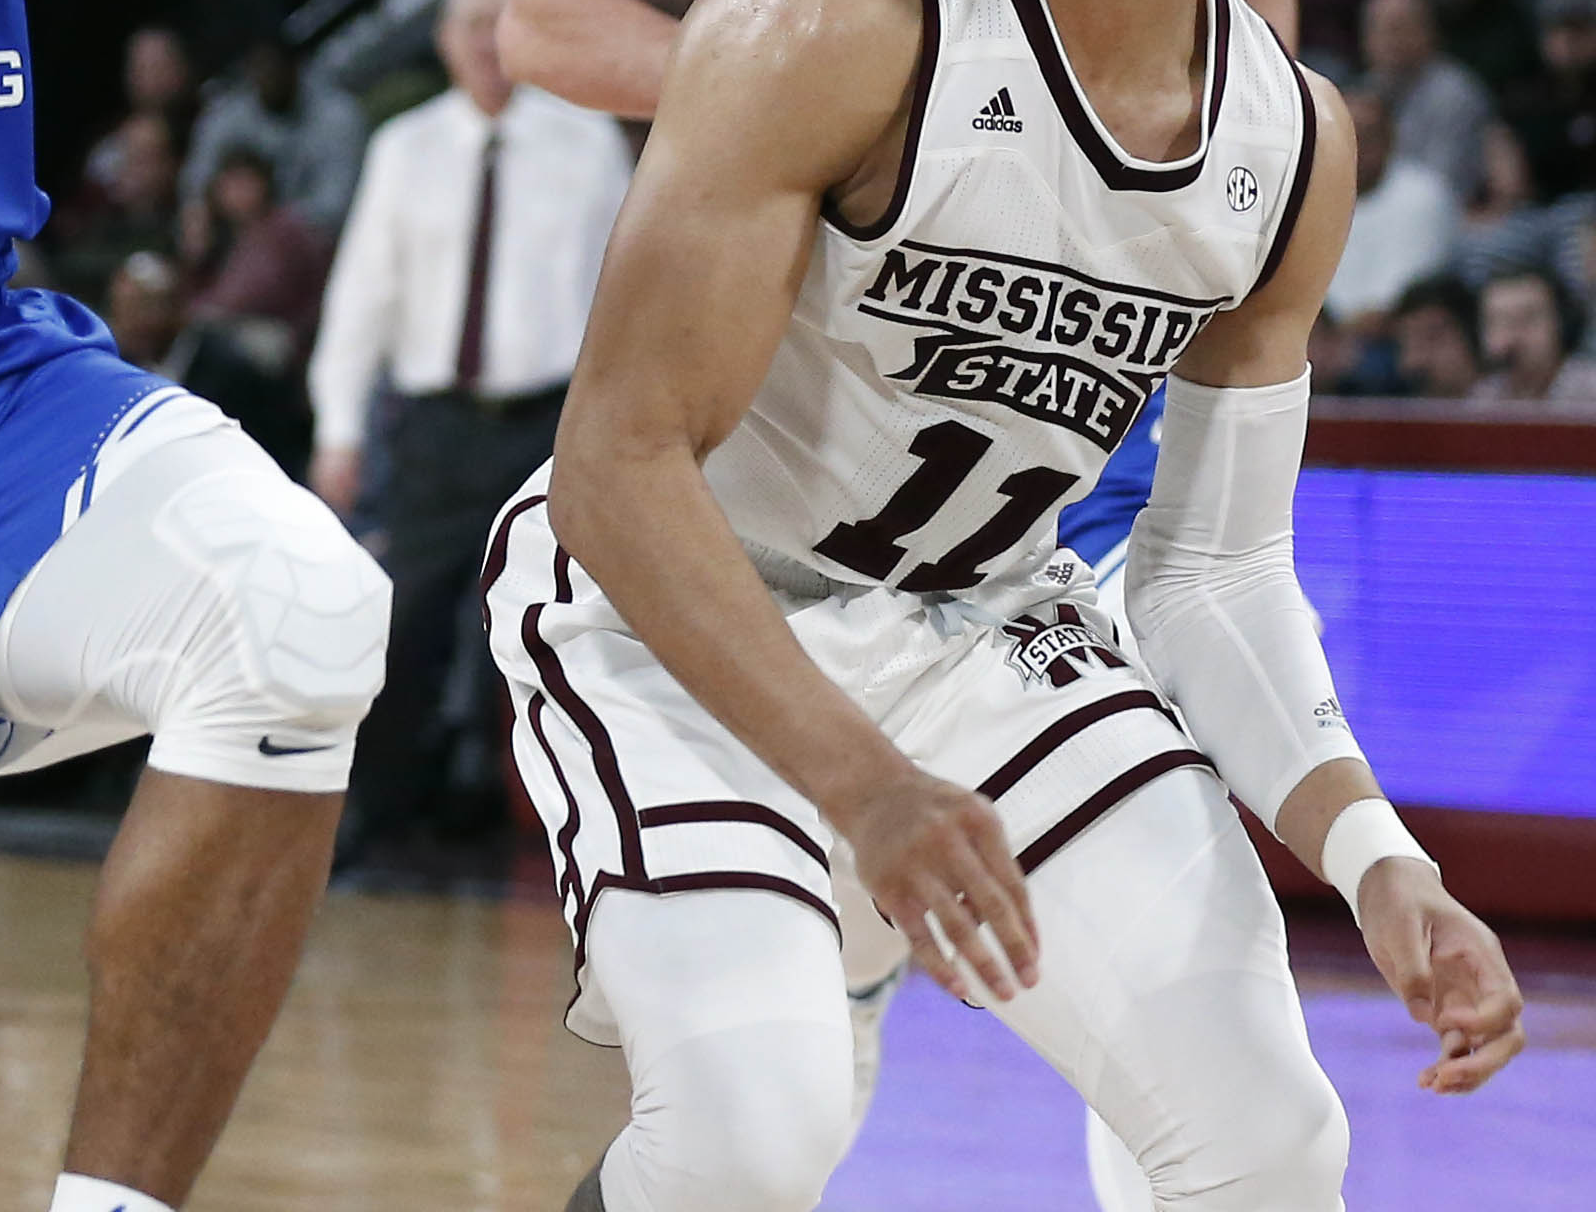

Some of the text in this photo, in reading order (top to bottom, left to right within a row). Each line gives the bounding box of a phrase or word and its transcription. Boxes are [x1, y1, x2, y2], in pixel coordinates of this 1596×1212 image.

[1226, 165, 1258, 212] SEC
[946, 354, 1127, 439] STATE
[812, 419, 1081, 590] 11
